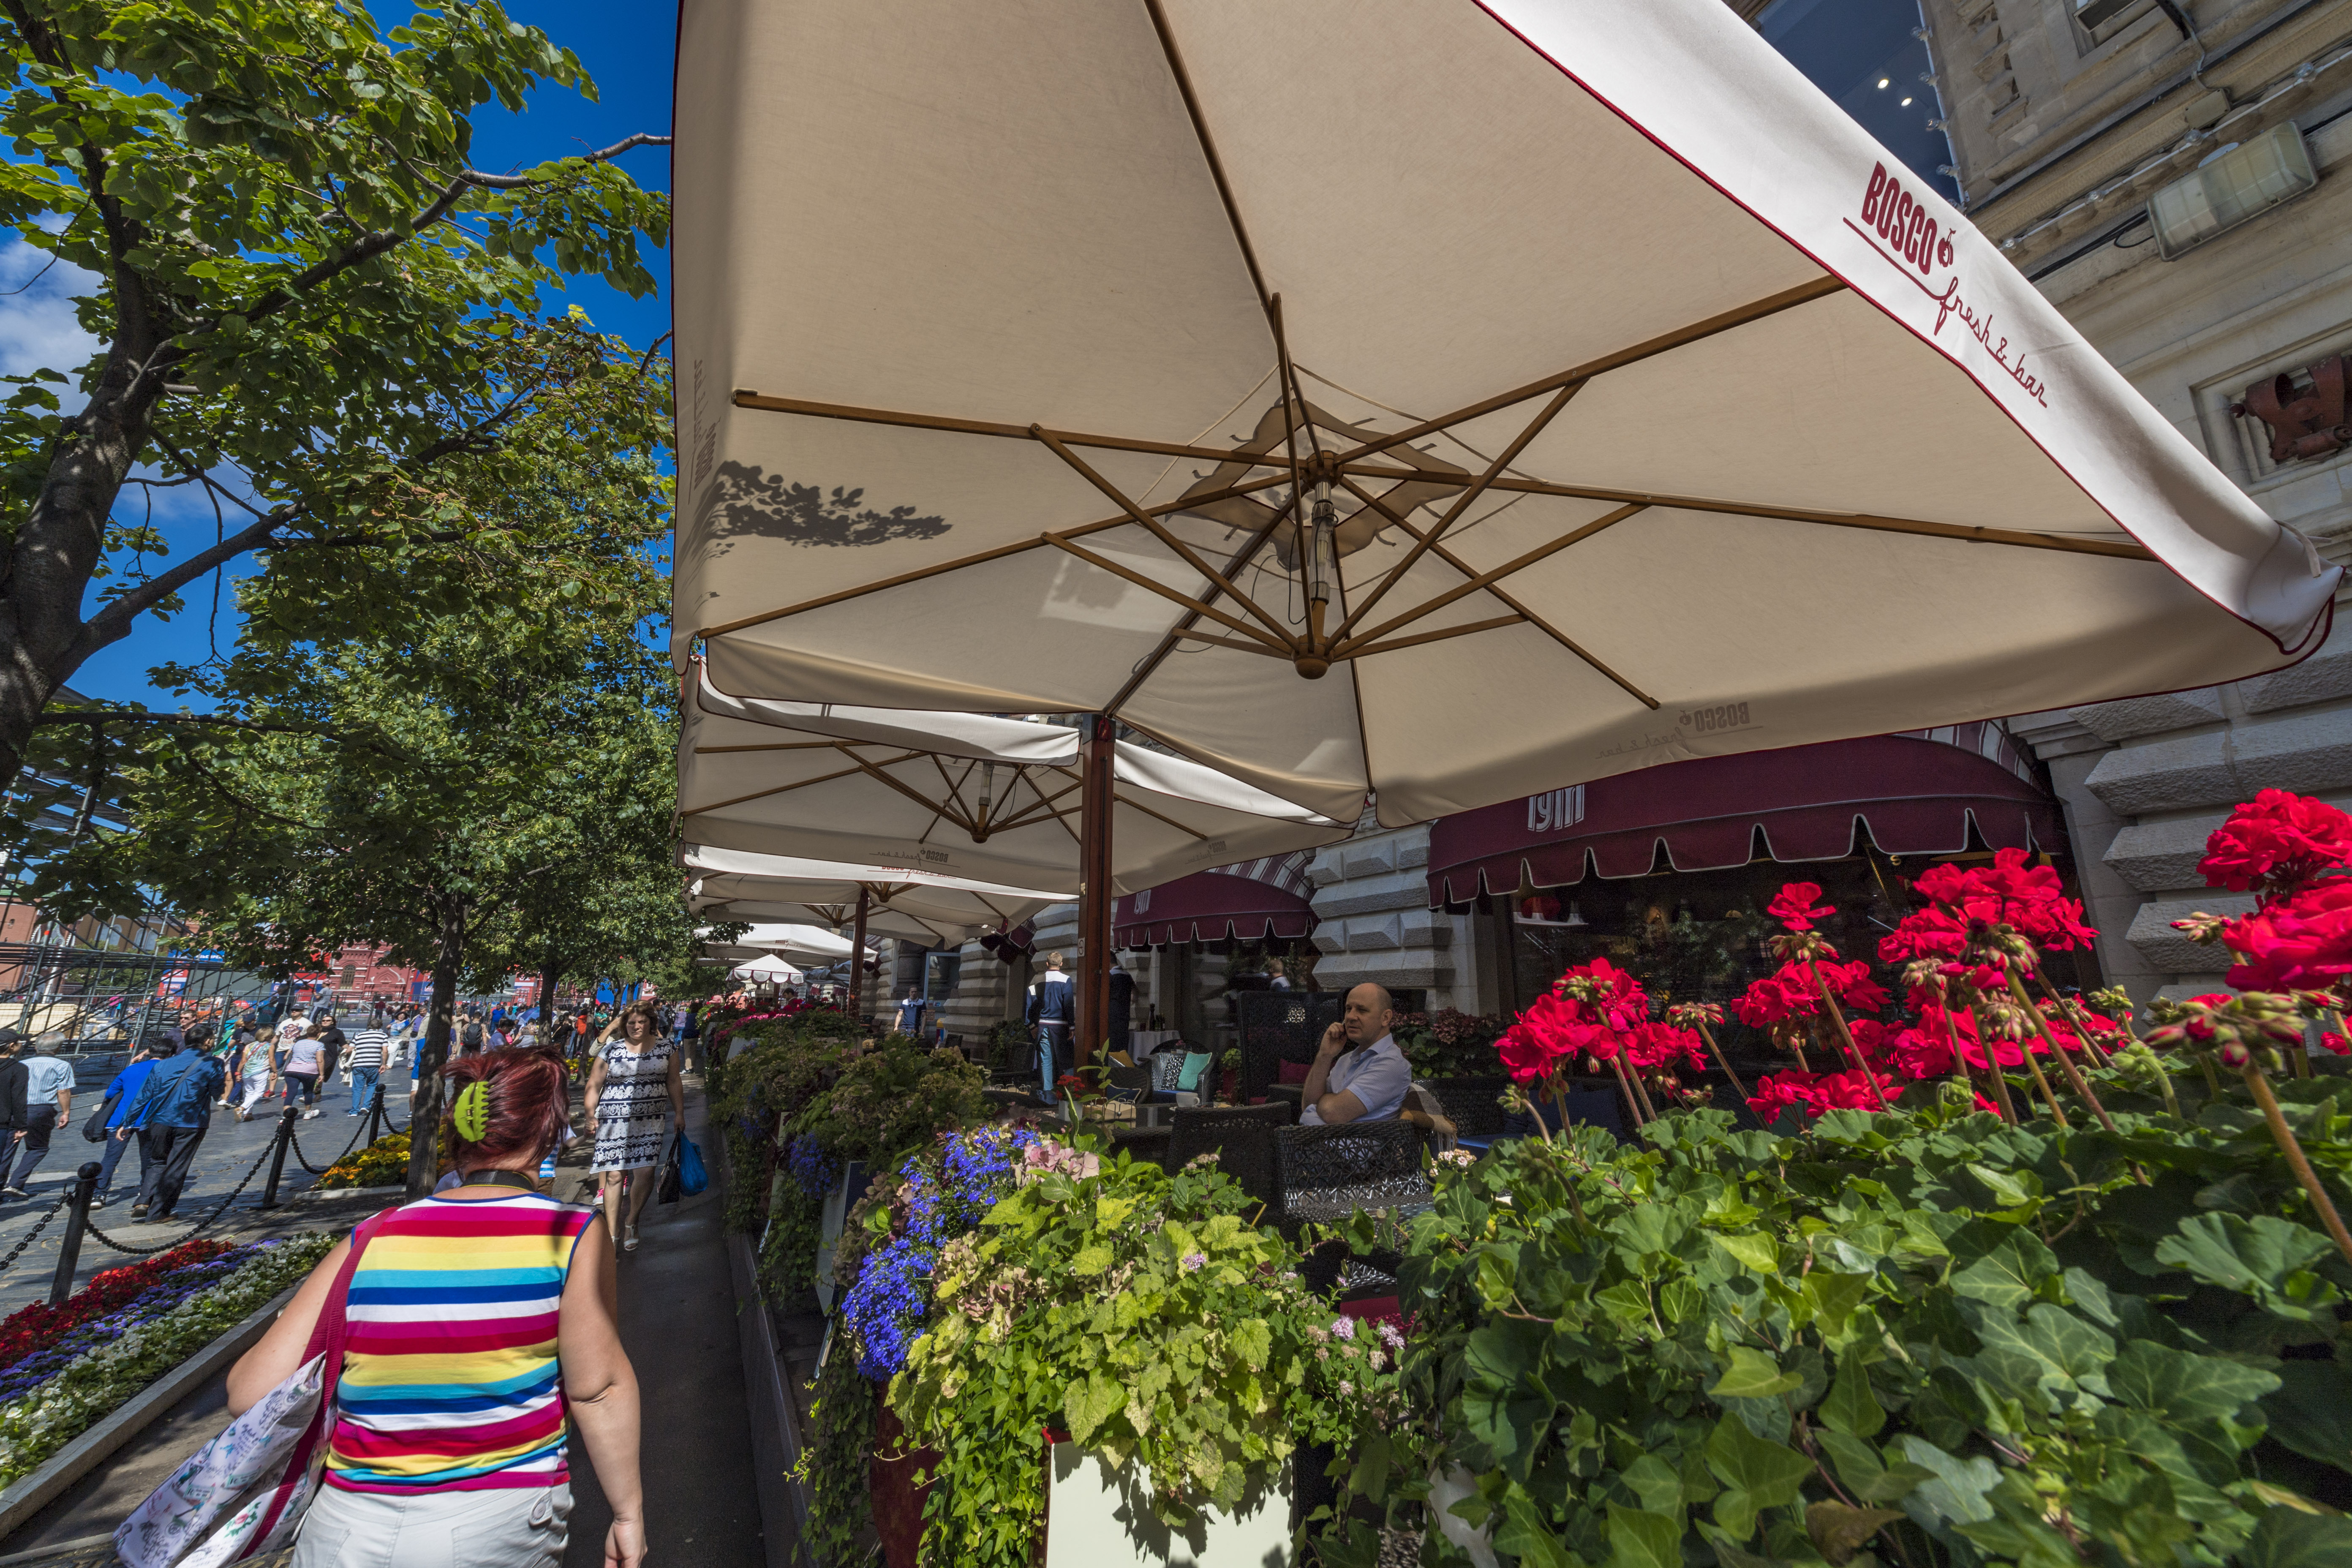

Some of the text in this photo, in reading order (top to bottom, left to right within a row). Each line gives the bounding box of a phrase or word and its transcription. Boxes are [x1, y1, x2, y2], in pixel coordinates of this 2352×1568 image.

[1861, 161, 1938, 275] BOSCO
[1934, 276, 2047, 408] fresh & bar
